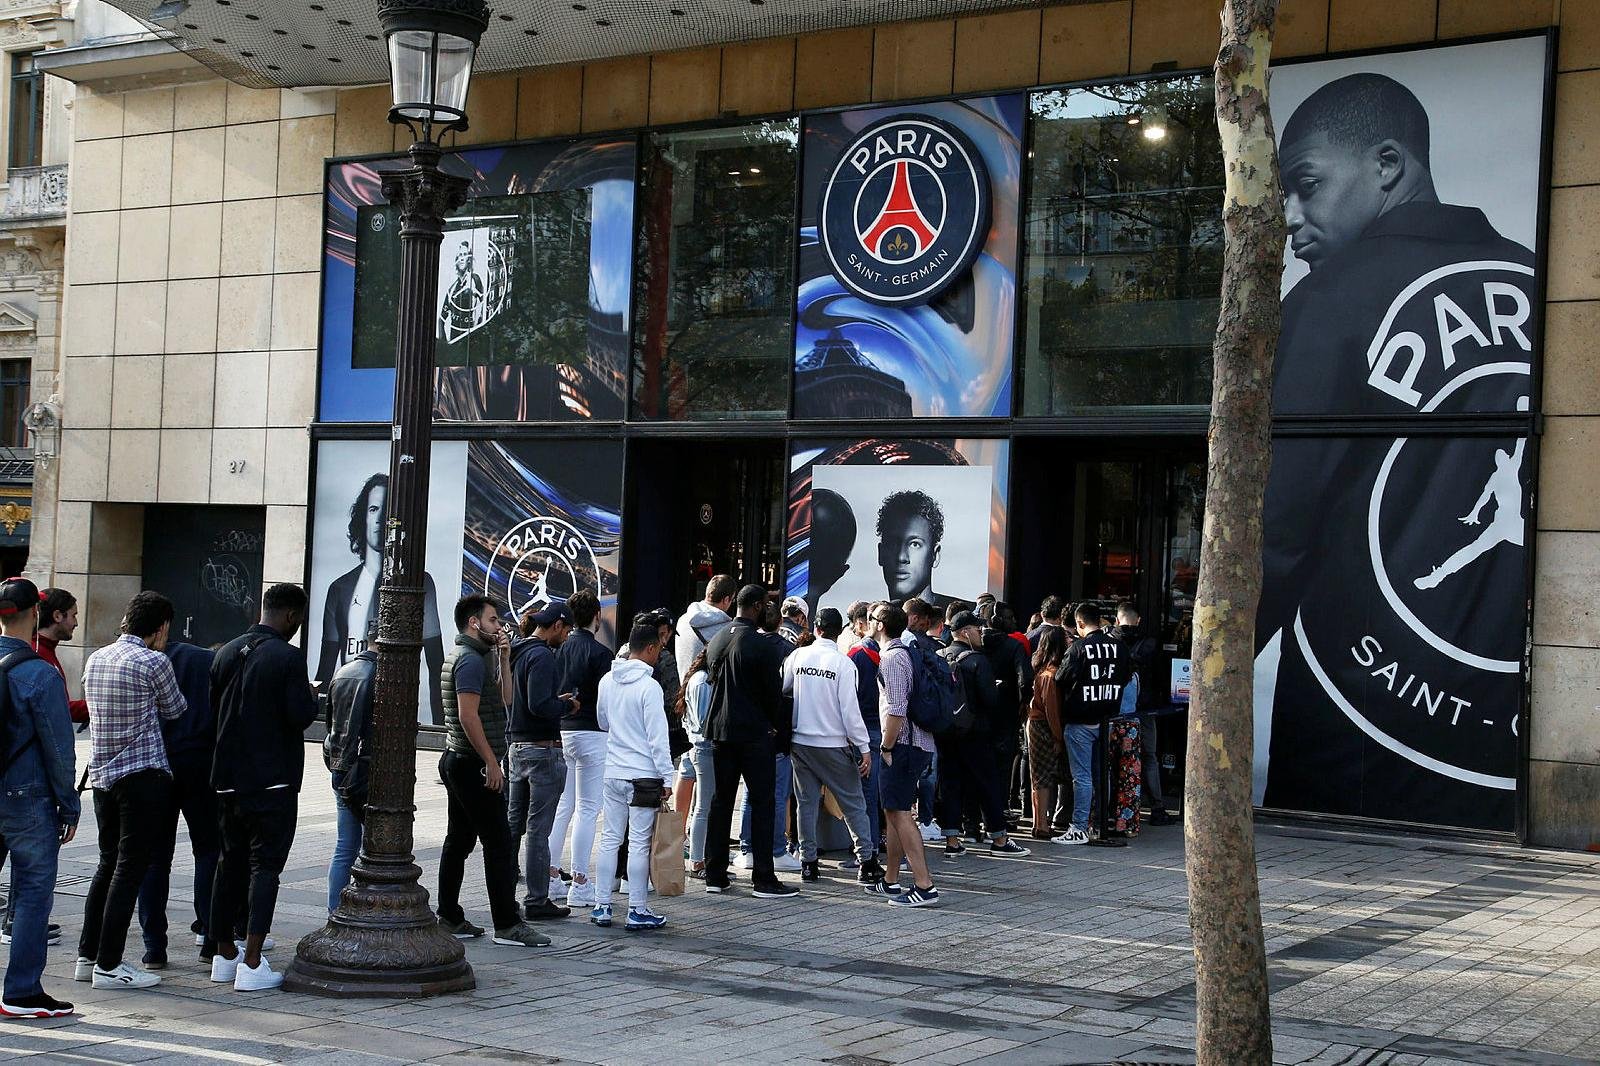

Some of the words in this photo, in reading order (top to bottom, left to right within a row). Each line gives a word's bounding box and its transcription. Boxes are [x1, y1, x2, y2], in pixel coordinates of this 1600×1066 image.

[850, 129, 952, 175] PARIS
[848, 253, 881, 282] SAINT
[892, 249, 949, 285] GERMAIN
[229, 460, 246, 474] 27
[505, 524, 581, 560] PARIS
[1084, 643, 1117, 660] CITY
[1083, 684, 1121, 701] FLIHT
[1351, 635, 1472, 725] SAINT
